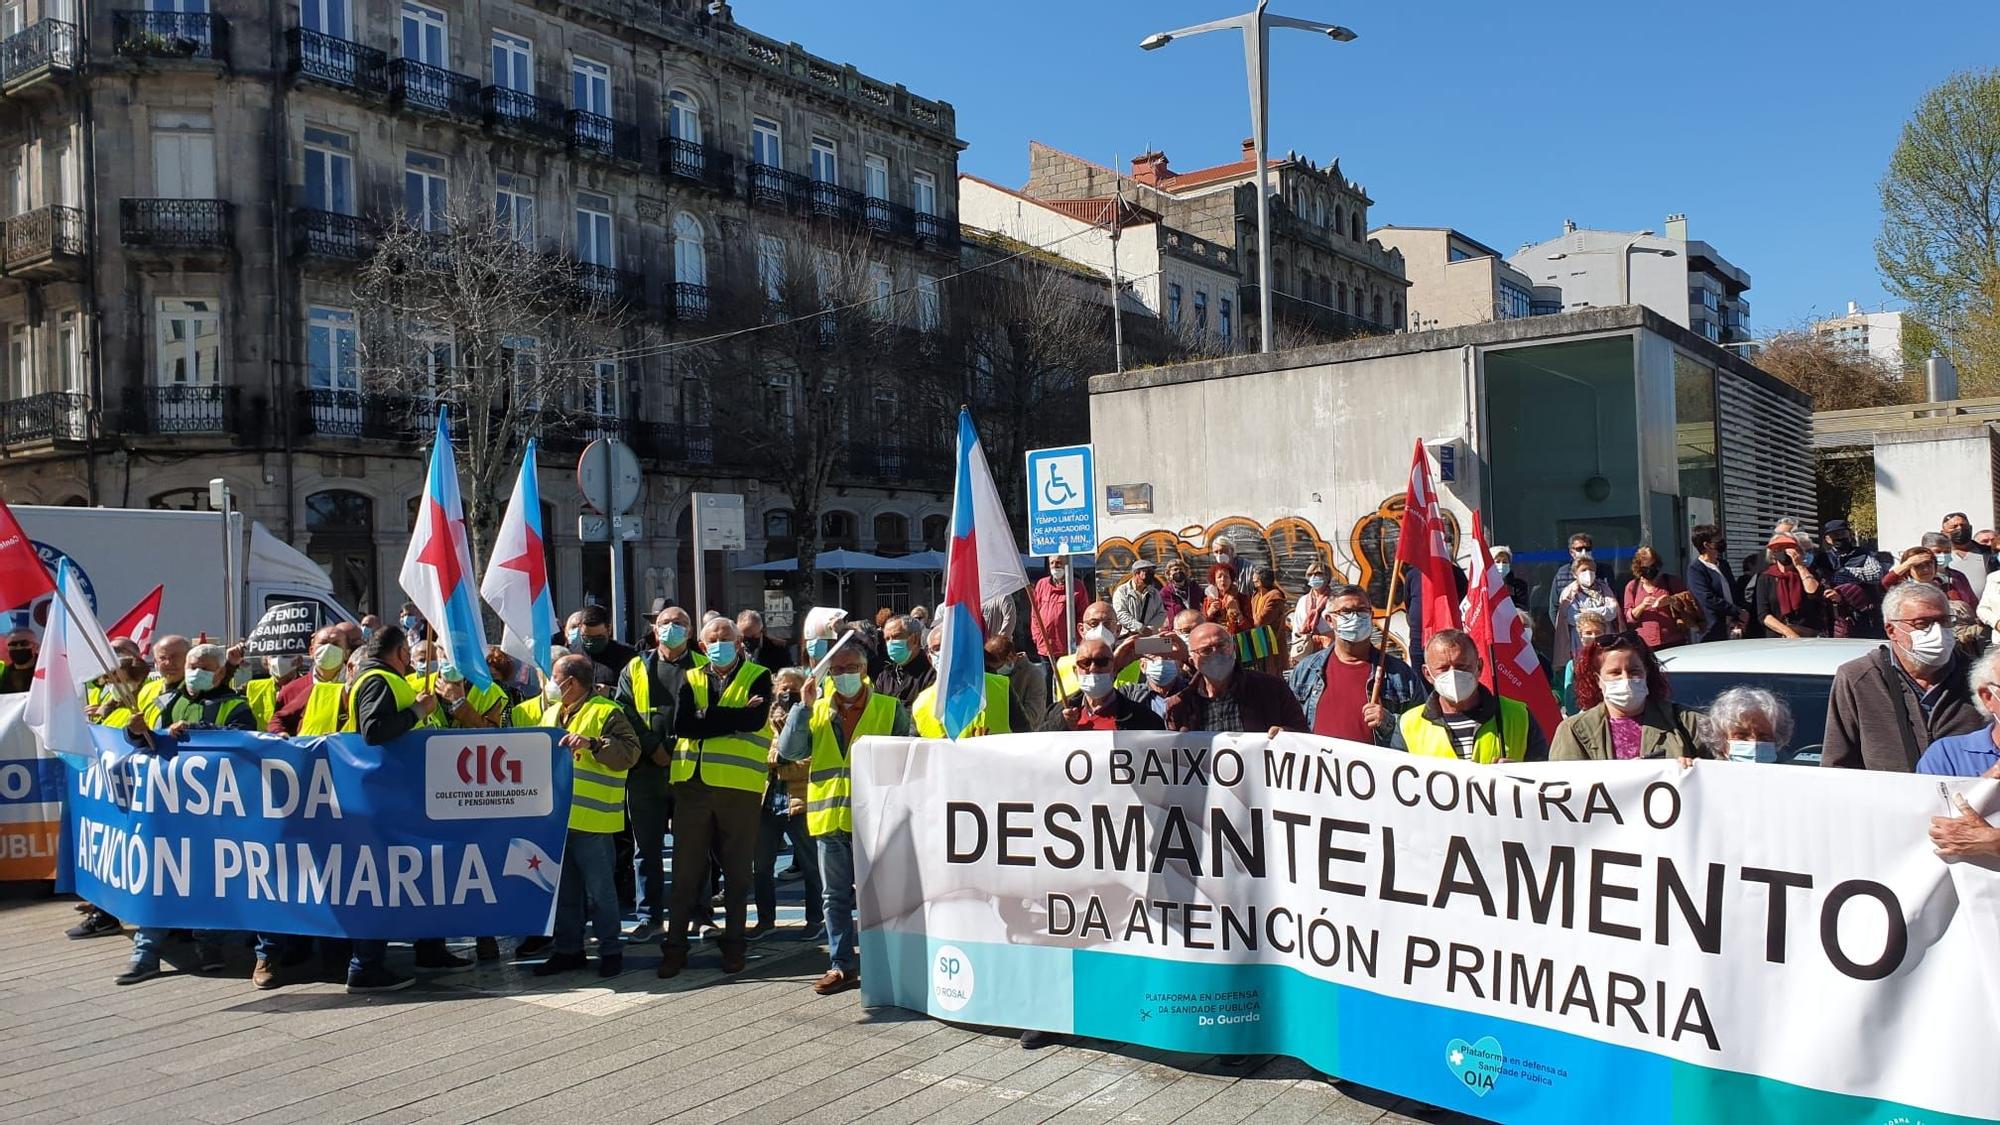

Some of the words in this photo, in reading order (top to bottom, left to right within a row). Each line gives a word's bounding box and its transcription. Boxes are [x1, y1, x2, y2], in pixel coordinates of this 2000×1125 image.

[1036, 516, 1057, 524] TEMPO
[1058, 514, 1089, 523] LIMITADO
[1045, 525, 1090, 534] APARCADOIRO
[256, 622, 313, 637] SANIDADE
[249, 638, 306, 653] PÚBLICA
[1497, 663, 1522, 687] Galega
[457, 745, 522, 785] CIG
[101, 750, 245, 816] DEFENSA
[261, 758, 343, 819] DA
[435, 791, 473, 799] COLECTIVO
[474, 790, 484, 798] DE
[486, 788, 539, 798] XUBILADOS/AS
[1065, 749, 1093, 787] O
[1110, 748, 1244, 788] BAIXO
[1265, 748, 1376, 801] MIÑO
[1392, 764, 1623, 825] CONTRA
[1643, 781, 1682, 829] O
[464, 798, 515, 807] PENSIONISTAS
[78, 816, 190, 897] ATENCIÓN
[214, 838, 497, 906] PRIMARIA
[945, 801, 1908, 981] DESMANTELAMENTO
[940, 956, 960, 981] sp
[1047, 893, 1111, 941] DA
[1124, 898, 1379, 978] ATENCIÓN
[1404, 936, 1721, 1051] PRIMARIA
[942, 987, 967, 999] ROSAL
[1145, 993, 1197, 1002] PLATAFORMA
[1199, 993, 1212, 1002] EN
[1214, 989, 1259, 1001] DEFENSA
[1158, 1005, 1169, 1014] DA
[1171, 1004, 1217, 1014] SANIDADE
[1198, 1016, 1214, 1026] Da
[1217, 1012, 1260, 1025] Guarda
[1460, 1045, 1508, 1064] Plataforma
[1509, 1057, 1521, 1066] en
[1522, 1058, 1556, 1074] defensa
[1556, 1069, 1568, 1078] da
[1464, 1070, 1495, 1090] OIA
[1478, 1061, 1519, 1077] Sanidade
[1521, 1070, 1553, 1086] Pública
